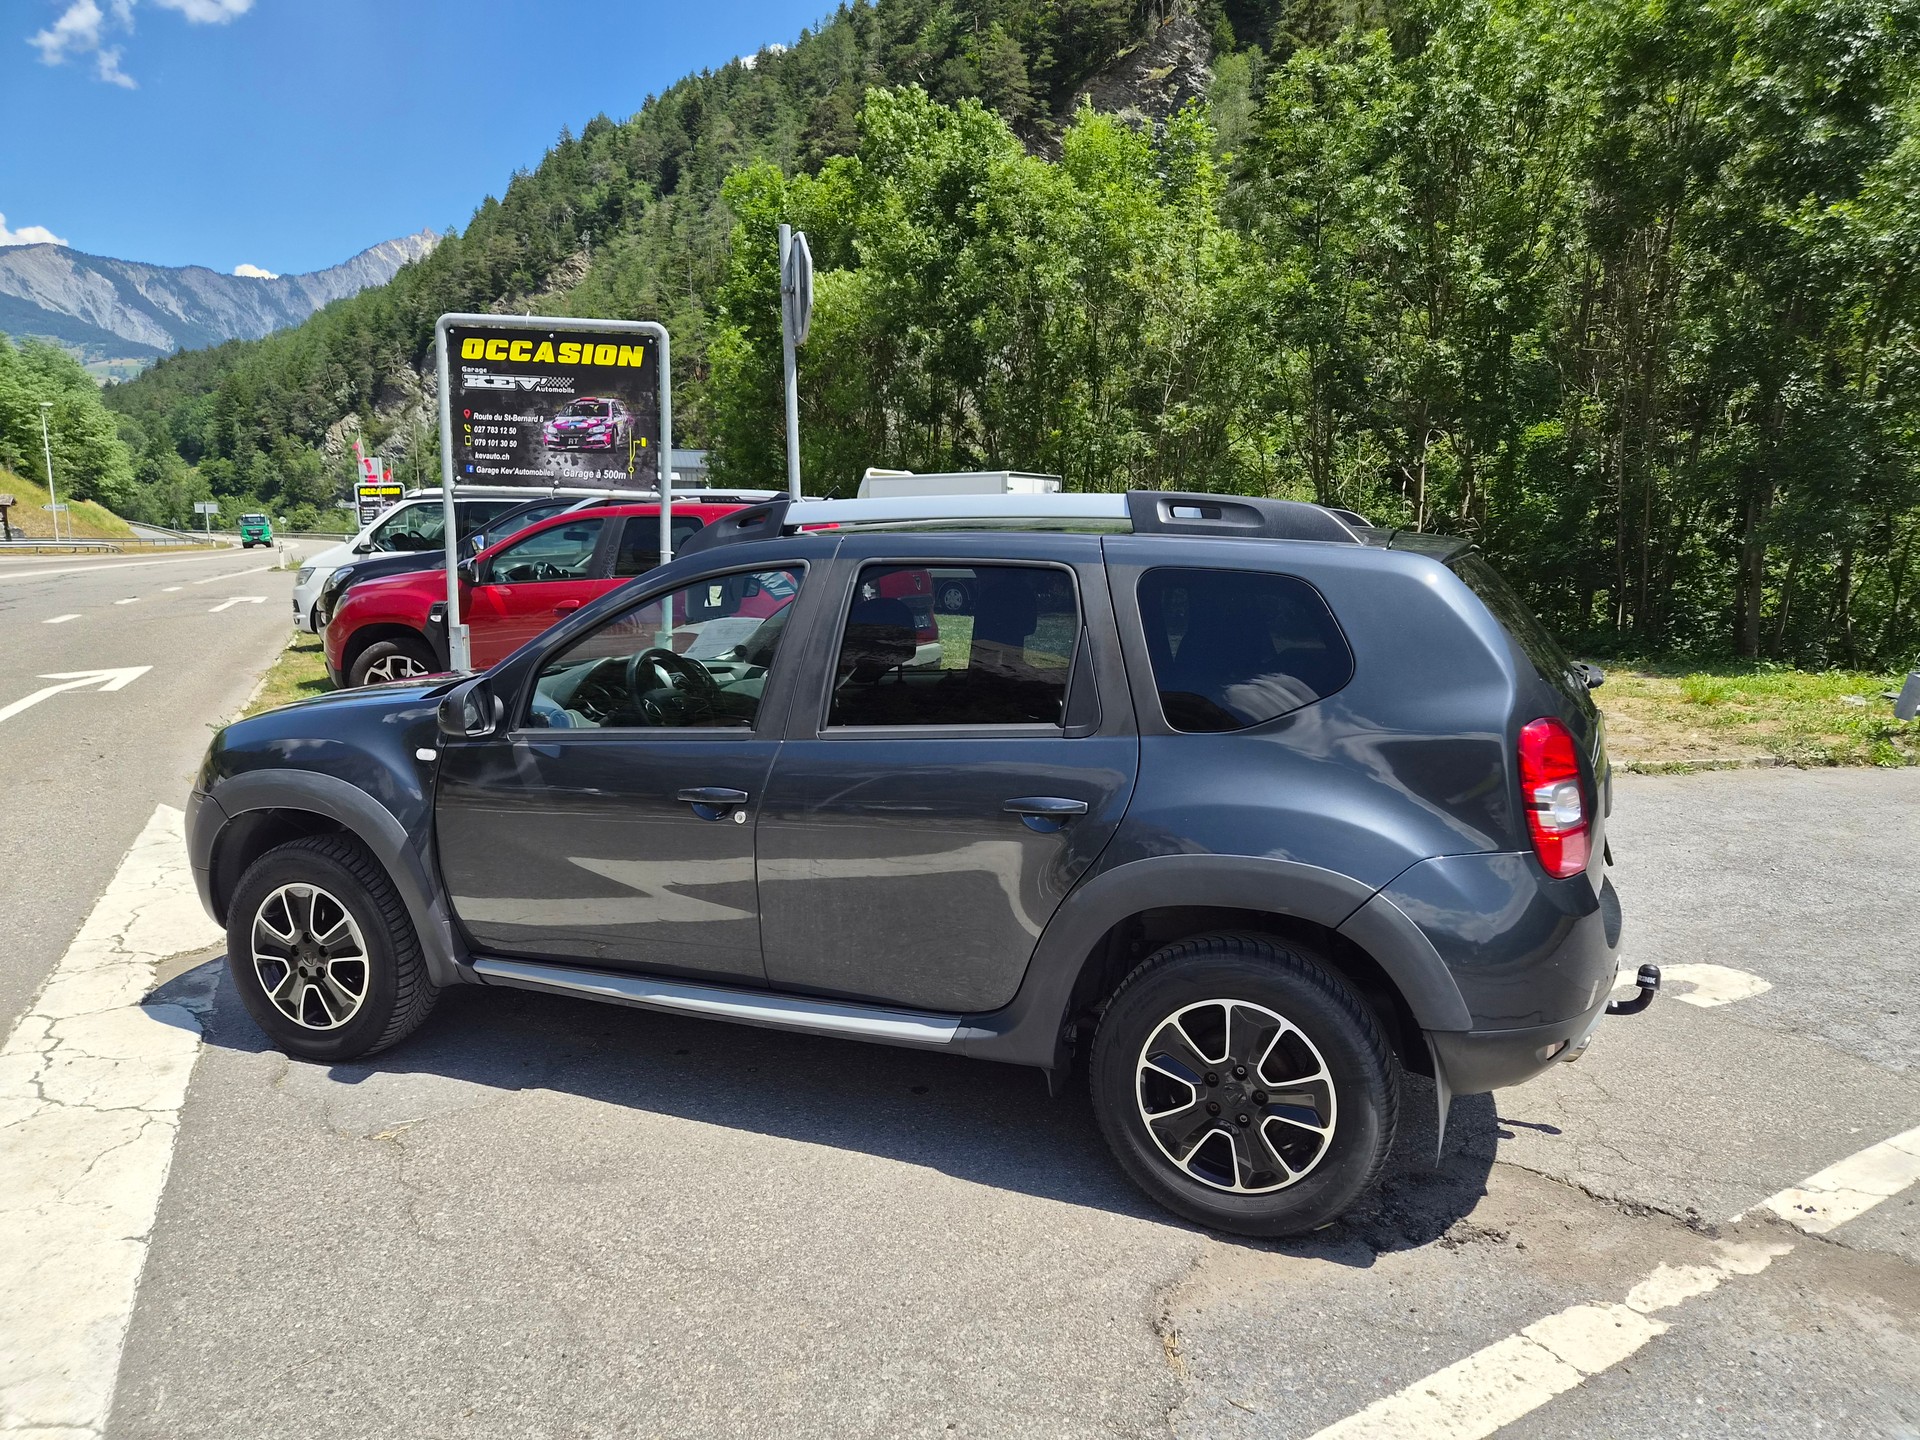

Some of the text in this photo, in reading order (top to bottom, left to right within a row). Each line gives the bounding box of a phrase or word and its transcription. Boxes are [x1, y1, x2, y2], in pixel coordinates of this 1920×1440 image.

[461, 338, 644, 367] OCCASION
[461, 366, 487, 374] Garage
[535, 386, 575, 394] Automobile
[473, 412, 544, 423] Route du St-Bernard 8
[473, 425, 517, 435] 027 783 12 50
[474, 438, 486, 446] 079
[487, 439, 499, 447] 101
[509, 440, 518, 448] 50
[474, 451, 510, 460] kevauto.ch
[476, 465, 499, 475] Garage
[563, 468, 627, 480] Garage à 500m
